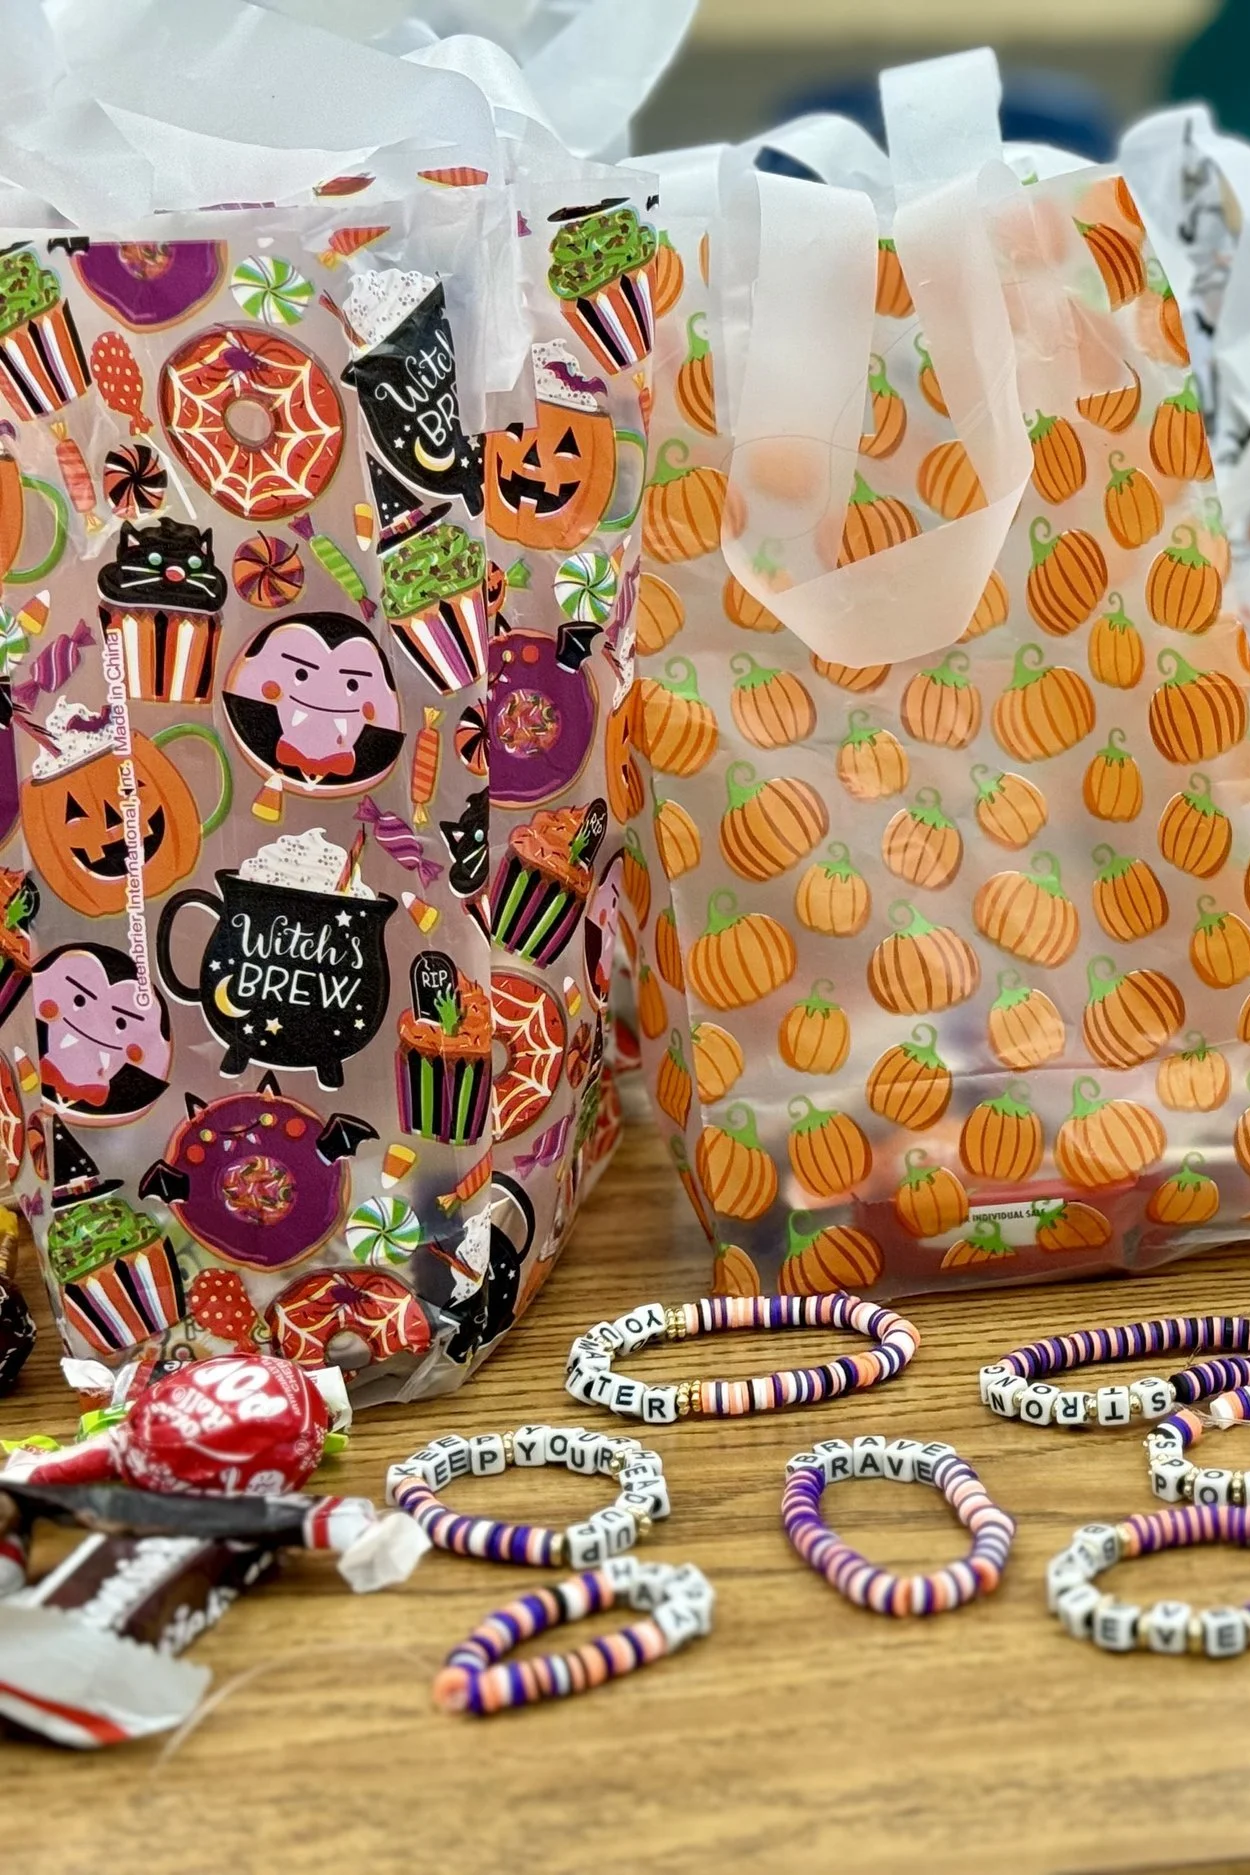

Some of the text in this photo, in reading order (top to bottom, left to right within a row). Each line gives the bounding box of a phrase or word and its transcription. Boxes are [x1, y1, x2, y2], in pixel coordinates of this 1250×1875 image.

[106, 631, 122, 681] China
[109, 685, 124, 700] in
[112, 704, 128, 752] Made
[129, 914, 150, 1008] Greenbrier
[231, 912, 364, 970] Witch's
[237, 961, 362, 1009] BREW
[421, 969, 448, 988] RIP
[972, 1210, 1024, 1222] INDIVIDUAL
[394, 1434, 498, 1485] KEEP
[517, 1426, 630, 1471] YOUR
[794, 1436, 947, 1481] BRAVE
